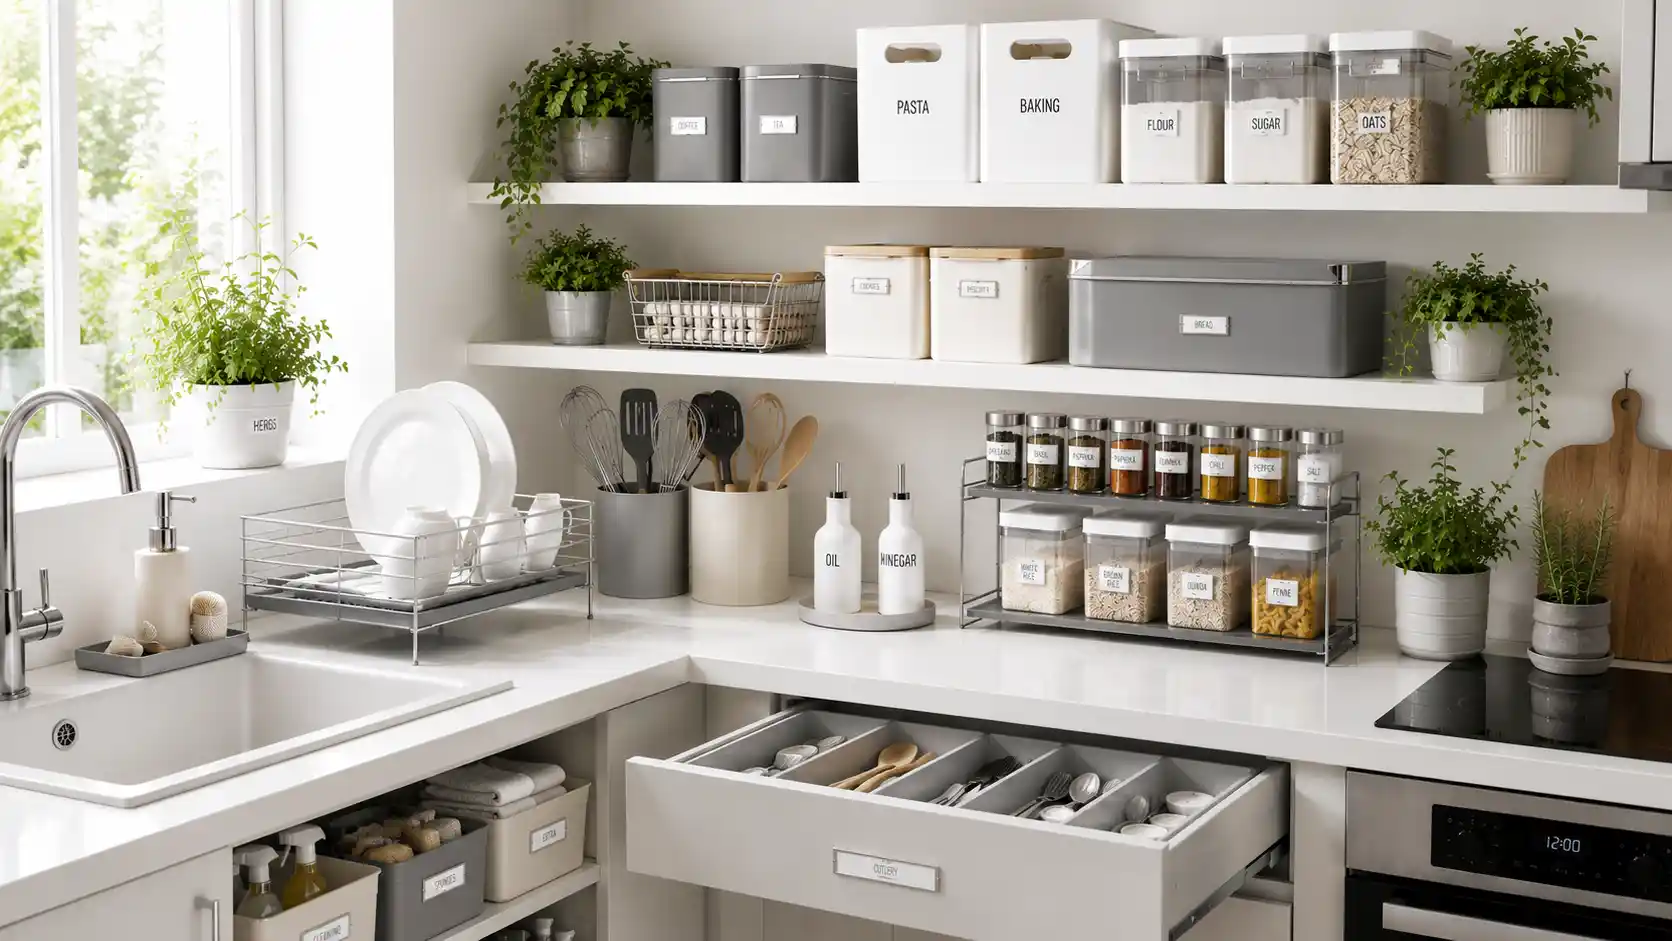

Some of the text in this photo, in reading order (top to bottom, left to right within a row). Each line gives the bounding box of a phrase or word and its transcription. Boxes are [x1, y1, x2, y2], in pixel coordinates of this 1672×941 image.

[897, 100, 930, 115] PASTA
[1020, 98, 1060, 114] BAKING
[1147, 118, 1174, 131] FLOUR
[1251, 117, 1281, 131] SUGAR
[1362, 115, 1386, 129] OATS
[1194, 320, 1213, 330] BREAD
[1253, 463, 1275, 473] PEPPER
[1307, 467, 1321, 476] SALT
[825, 553, 840, 568] OIL
[1546, 836, 1581, 853] 12:00
[873, 863, 899, 877] CUTLERY
